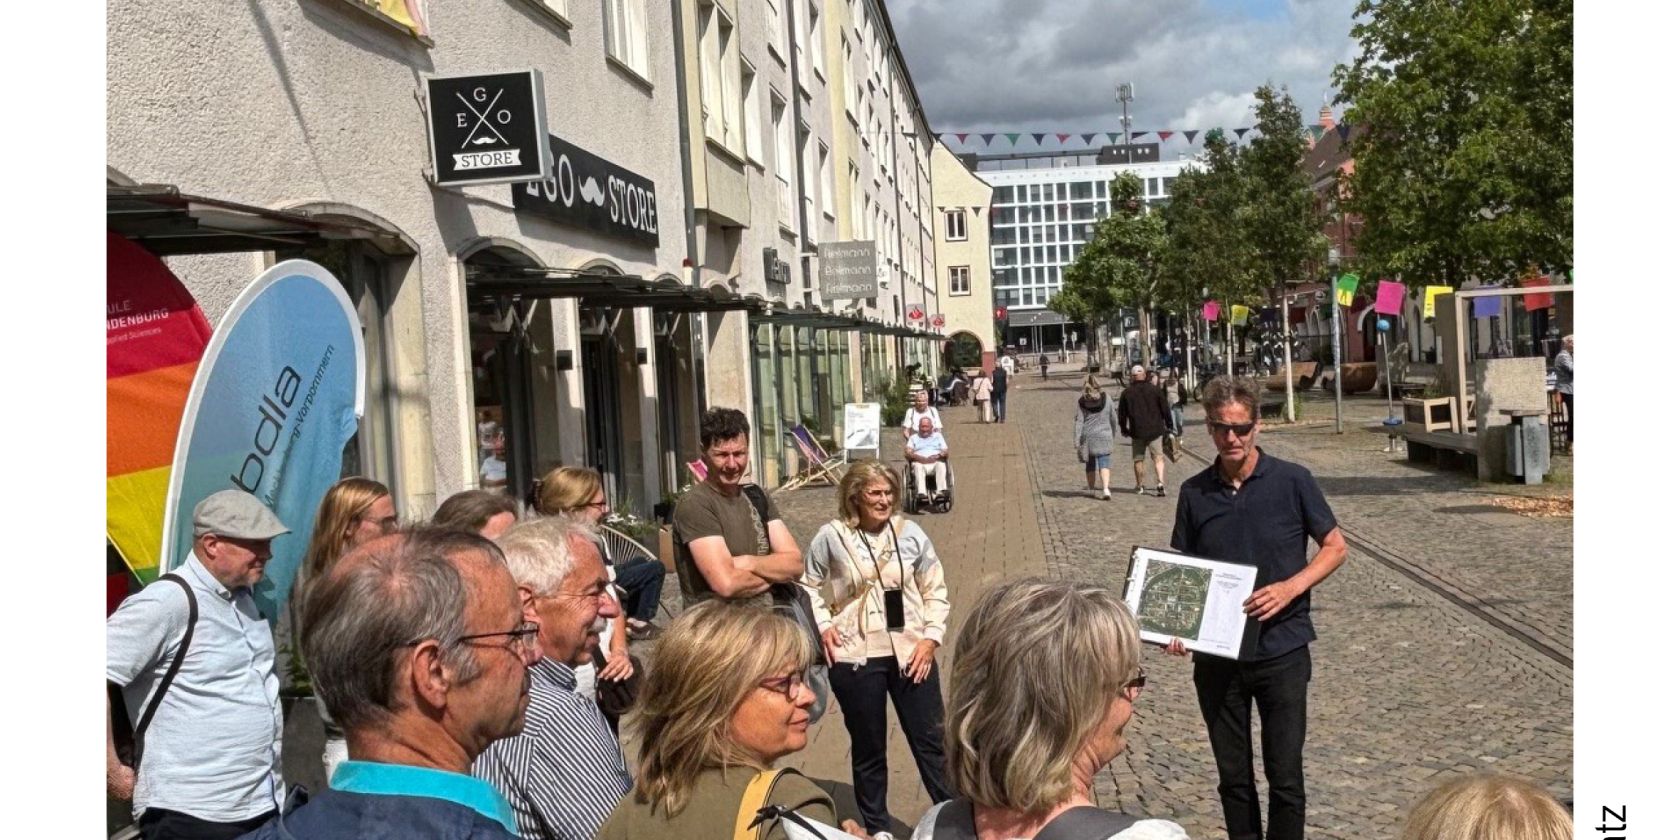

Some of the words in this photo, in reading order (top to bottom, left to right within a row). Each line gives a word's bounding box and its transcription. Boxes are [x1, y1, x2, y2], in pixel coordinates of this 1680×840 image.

[461, 151, 514, 168] STORE
[607, 175, 657, 235] STORE
[230, 365, 302, 494] bdla
